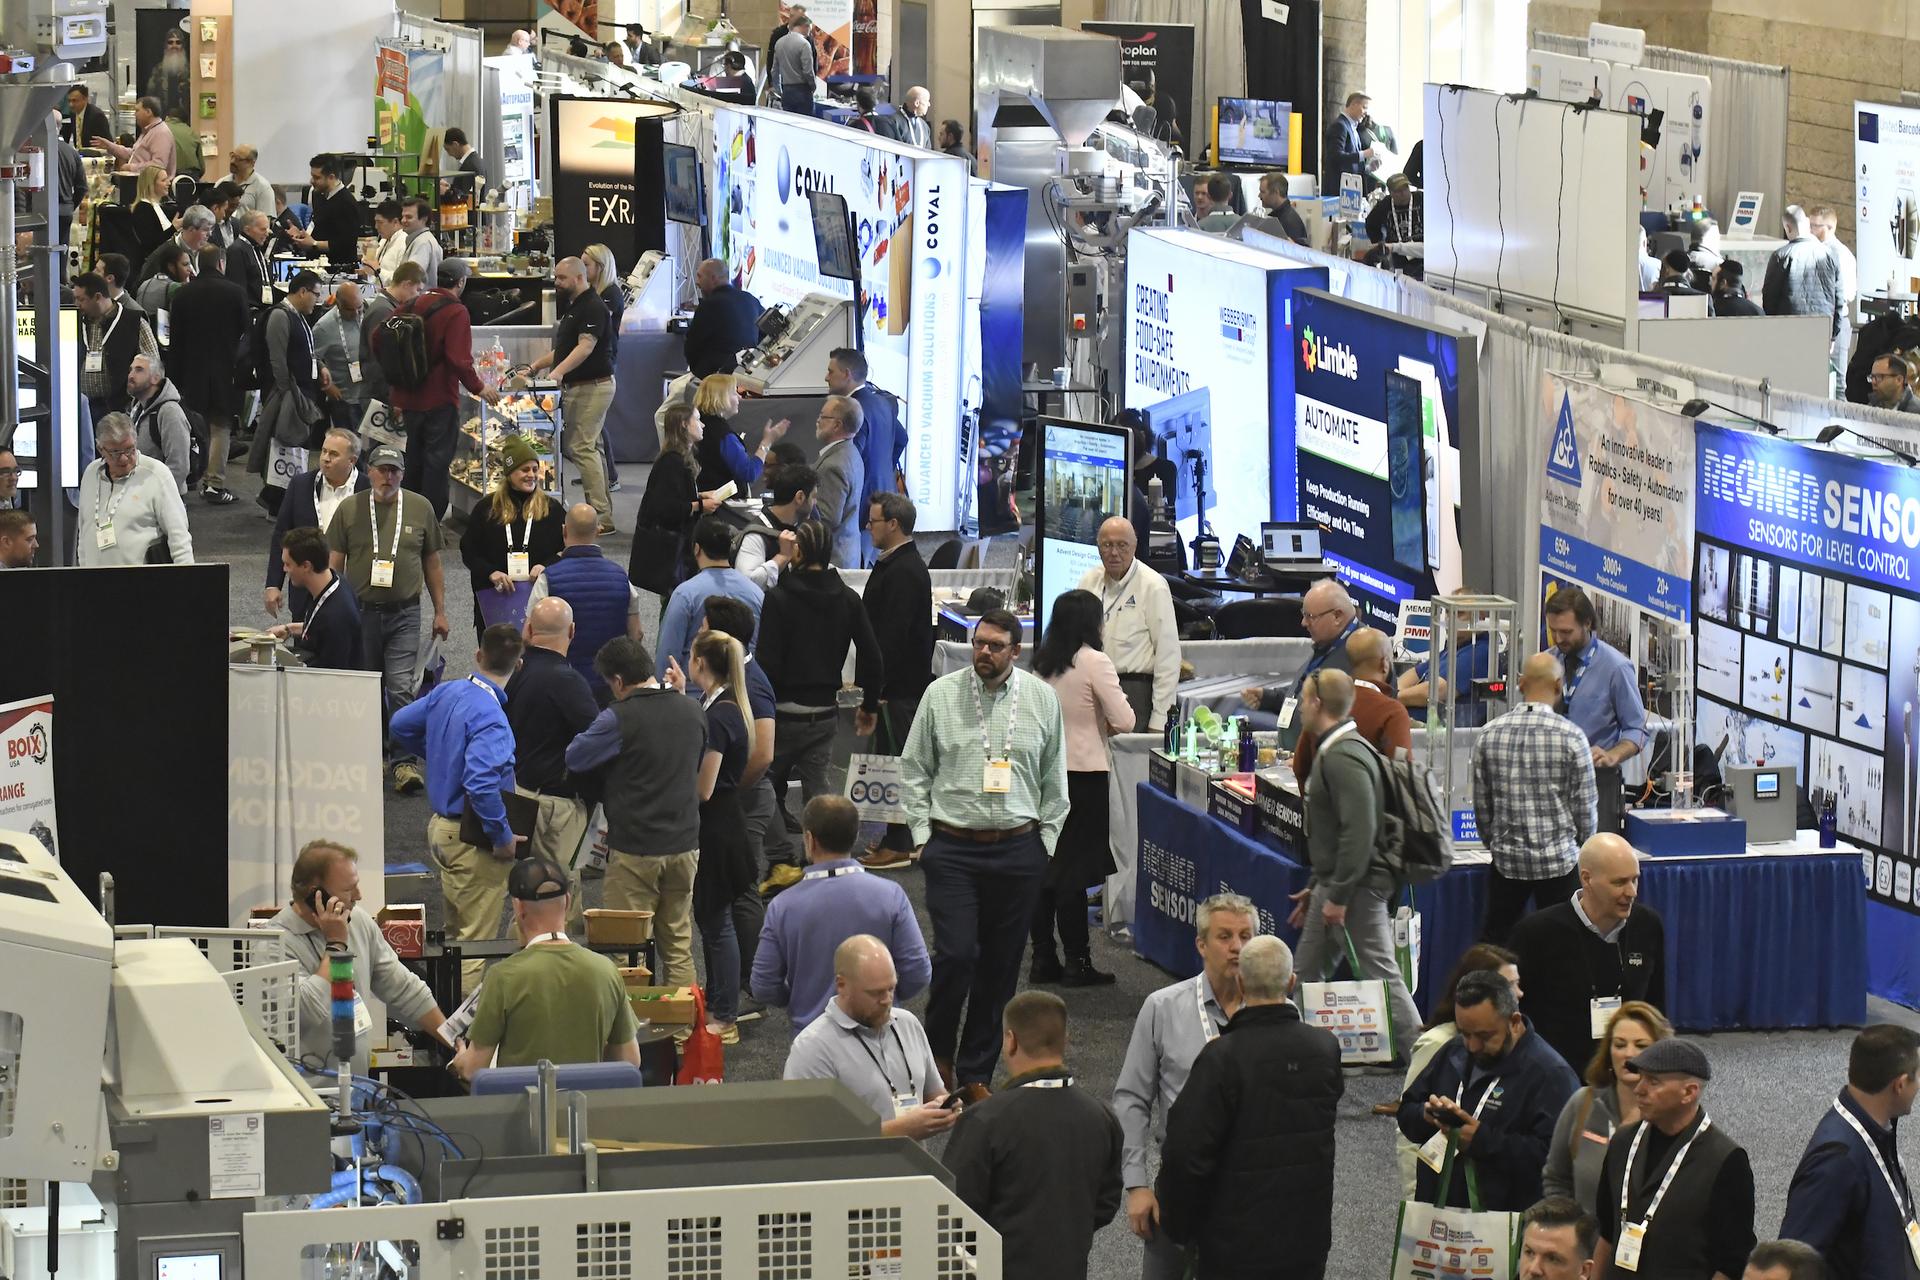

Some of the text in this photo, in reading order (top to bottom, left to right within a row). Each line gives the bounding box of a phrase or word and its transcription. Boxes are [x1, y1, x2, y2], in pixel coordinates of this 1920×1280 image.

[1121, 45, 1156, 57] oplan
[588, 182, 614, 190] Evolution
[796, 165, 834, 199] COVAL
[588, 194, 634, 226] EXR
[926, 185, 940, 249] COVAL
[1136, 283, 1168, 324] CREATING
[16, 318, 28, 326] LK
[1136, 318, 1174, 361] FOOD-SAFE
[1135, 354, 1190, 396] ENVIRONMENTS
[1316, 336, 1358, 380] Limble
[918, 292, 936, 505] ADVANCED VACUUM SOLUTIONS
[1305, 404, 1359, 444] AUTOMATE
[1601, 434, 1672, 474] An innovative leader in
[1588, 454, 1617, 480] Robotics
[1622, 467, 1642, 492] Safety
[1648, 478, 1684, 503] Automation
[1704, 448, 1820, 524] RECHNER
[1306, 478, 1370, 518] Keep Production Running
[1545, 489, 1581, 516] Advent Design
[1608, 488, 1663, 523] for over 40 years!
[1306, 504, 1365, 540] Efficiently and On Time
[1554, 536, 1570, 556] 650+
[1748, 518, 1910, 581] SENSORS FOR LEVEL CONTROL
[1603, 556, 1622, 577] 3000+
[1657, 577, 1669, 595] 20+
[1405, 605, 1432, 613] MEMB
[1404, 627, 1431, 637] PMM
[8, 734, 41, 760] BOIX
[10, 760, 20, 768] USA
[1275, 802, 1302, 828] SENSORS
[1150, 880, 1198, 928] SENSOR
